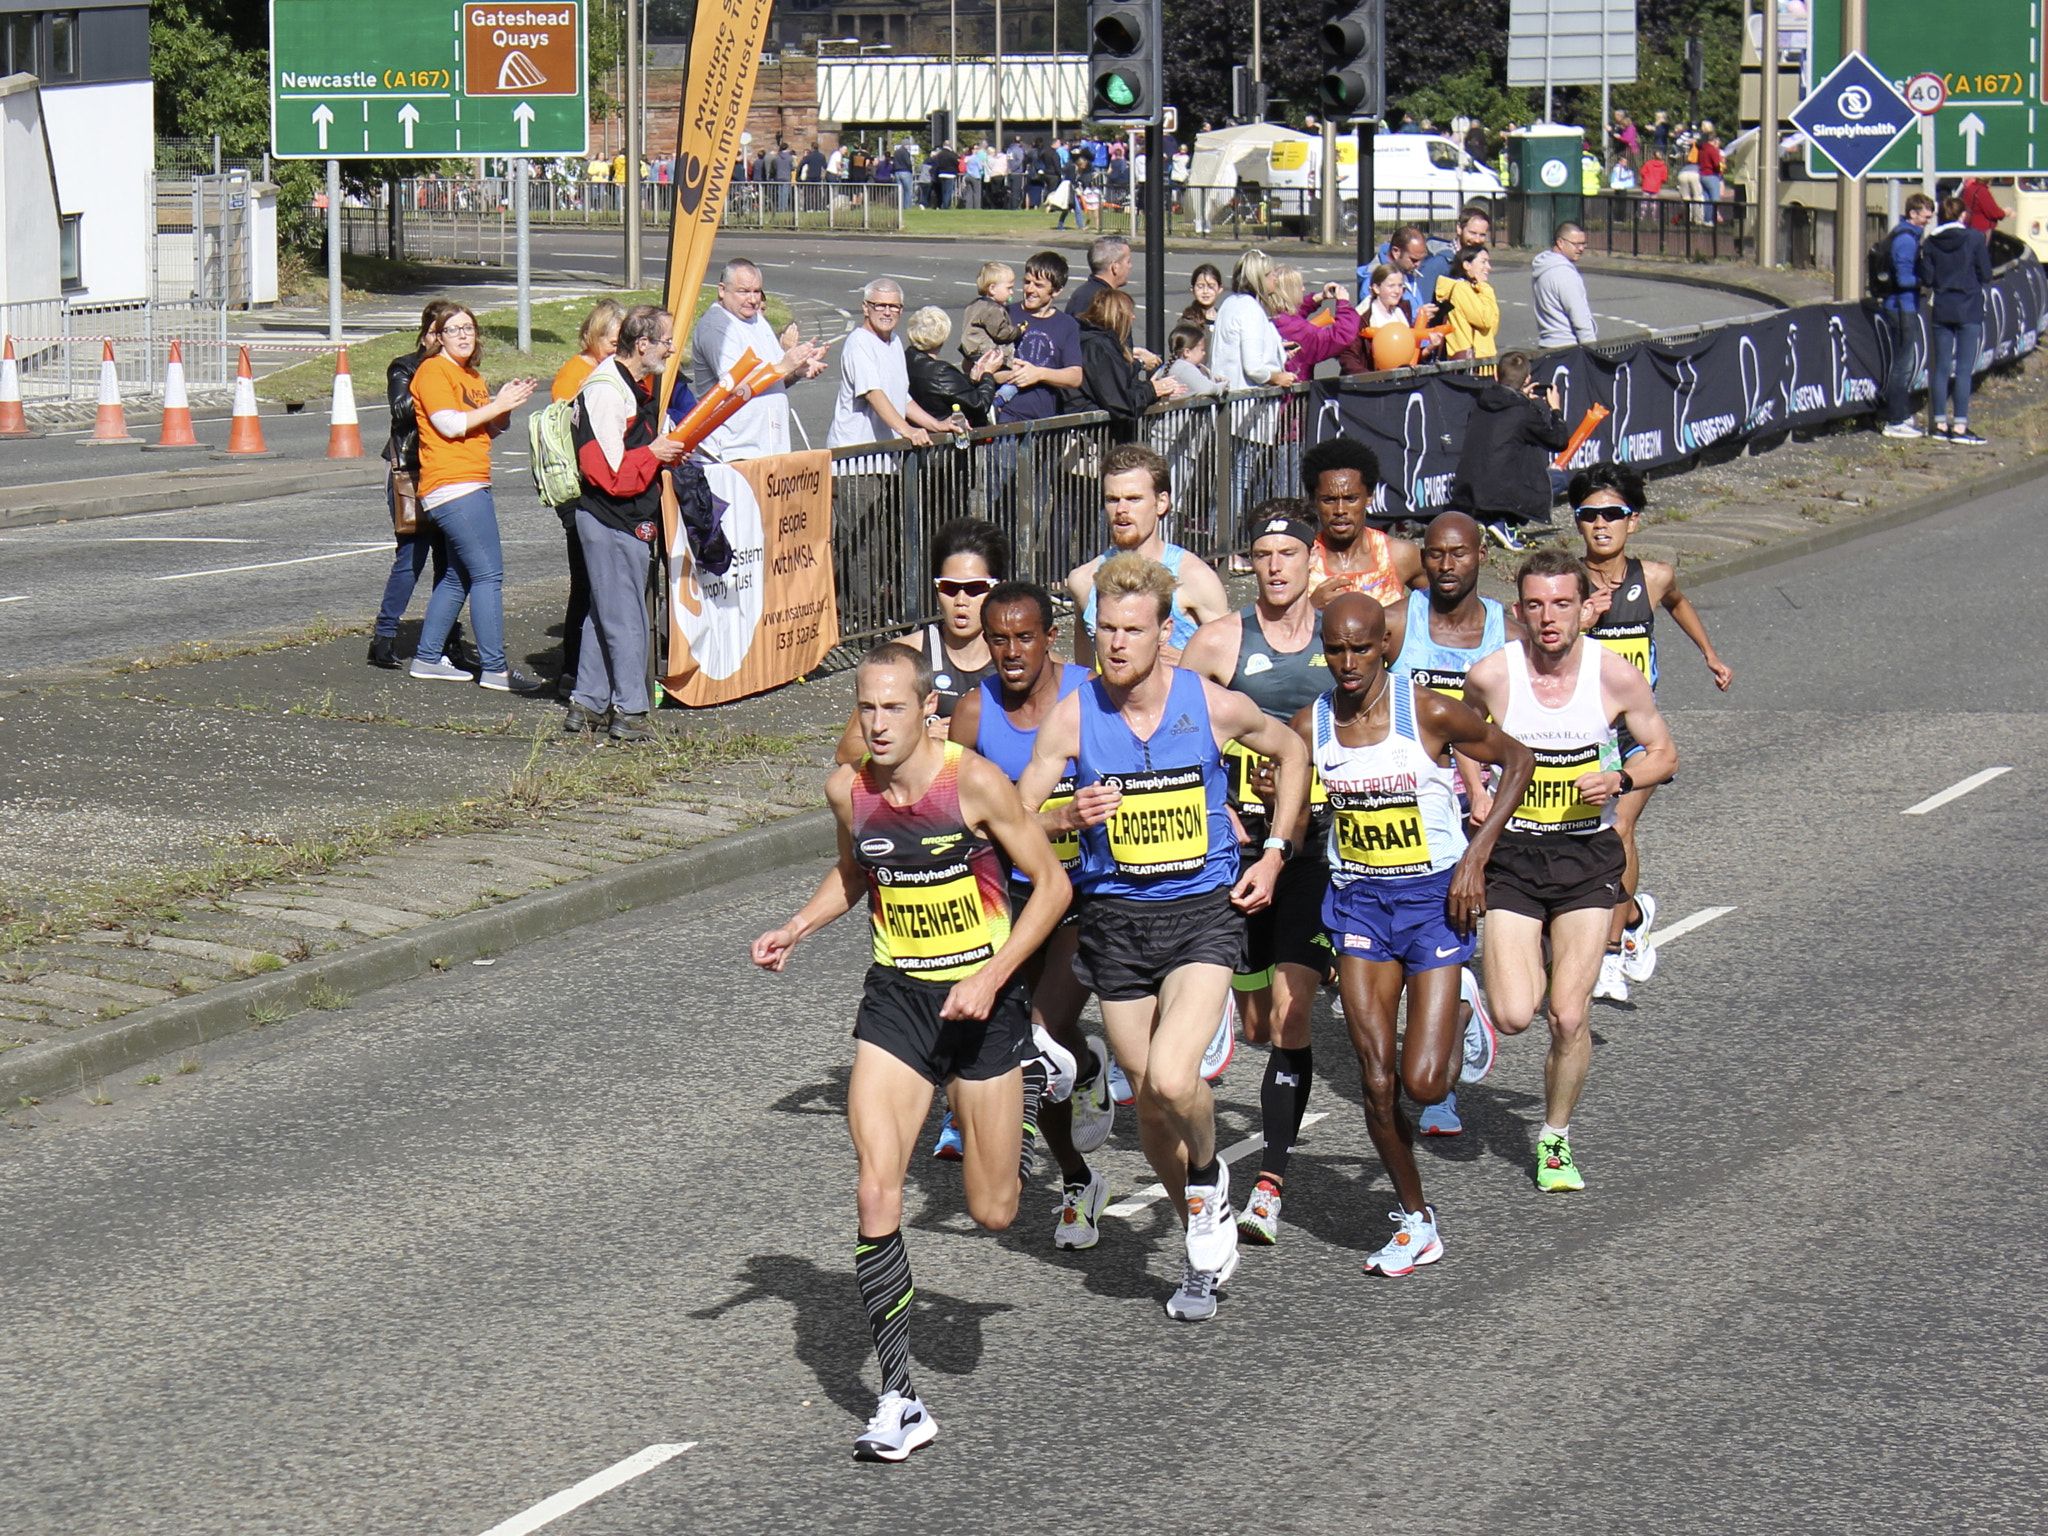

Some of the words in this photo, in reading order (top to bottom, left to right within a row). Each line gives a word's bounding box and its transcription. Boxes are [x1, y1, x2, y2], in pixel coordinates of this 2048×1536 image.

[471, 9, 570, 26] Gateshead
[492, 29, 550, 49] Quays
[281, 71, 377, 88] Newcastle
[694, 21, 727, 131] Multiple
[704, 29, 735, 140] Atrophy
[1909, 84, 1940, 102] 40
[1812, 122, 1897, 139] Simplyhealth
[766, 466, 820, 502] Supporting
[778, 507, 807, 542] people
[731, 546, 763, 568] Sstem
[1591, 623, 1647, 638] Simplyhealth
[1170, 725, 1200, 736] adidas
[1515, 731, 1562, 741] SWANSEA
[1533, 748, 1597, 766] Simplyhealth
[1124, 771, 1201, 791] Simplyhealth
[1323, 778, 1360, 793] GREAT
[1362, 771, 1418, 793] BRITAIN
[1347, 794, 1414, 809] Simplyhealth
[1110, 803, 1204, 846] Z.ROBERTSON
[1338, 816, 1422, 851] FARAH
[1514, 818, 1597, 832] #GREATNORTHRUN
[920, 832, 964, 846] BROOKS
[893, 862, 969, 884] Simplyhealth
[1118, 856, 1205, 876] #GREATNORTHRUN
[1343, 860, 1430, 876] #GREATNORTHRUN
[885, 892, 981, 939] RITZENHEIN
[894, 945, 990, 970] #GREATNORTHRUN
